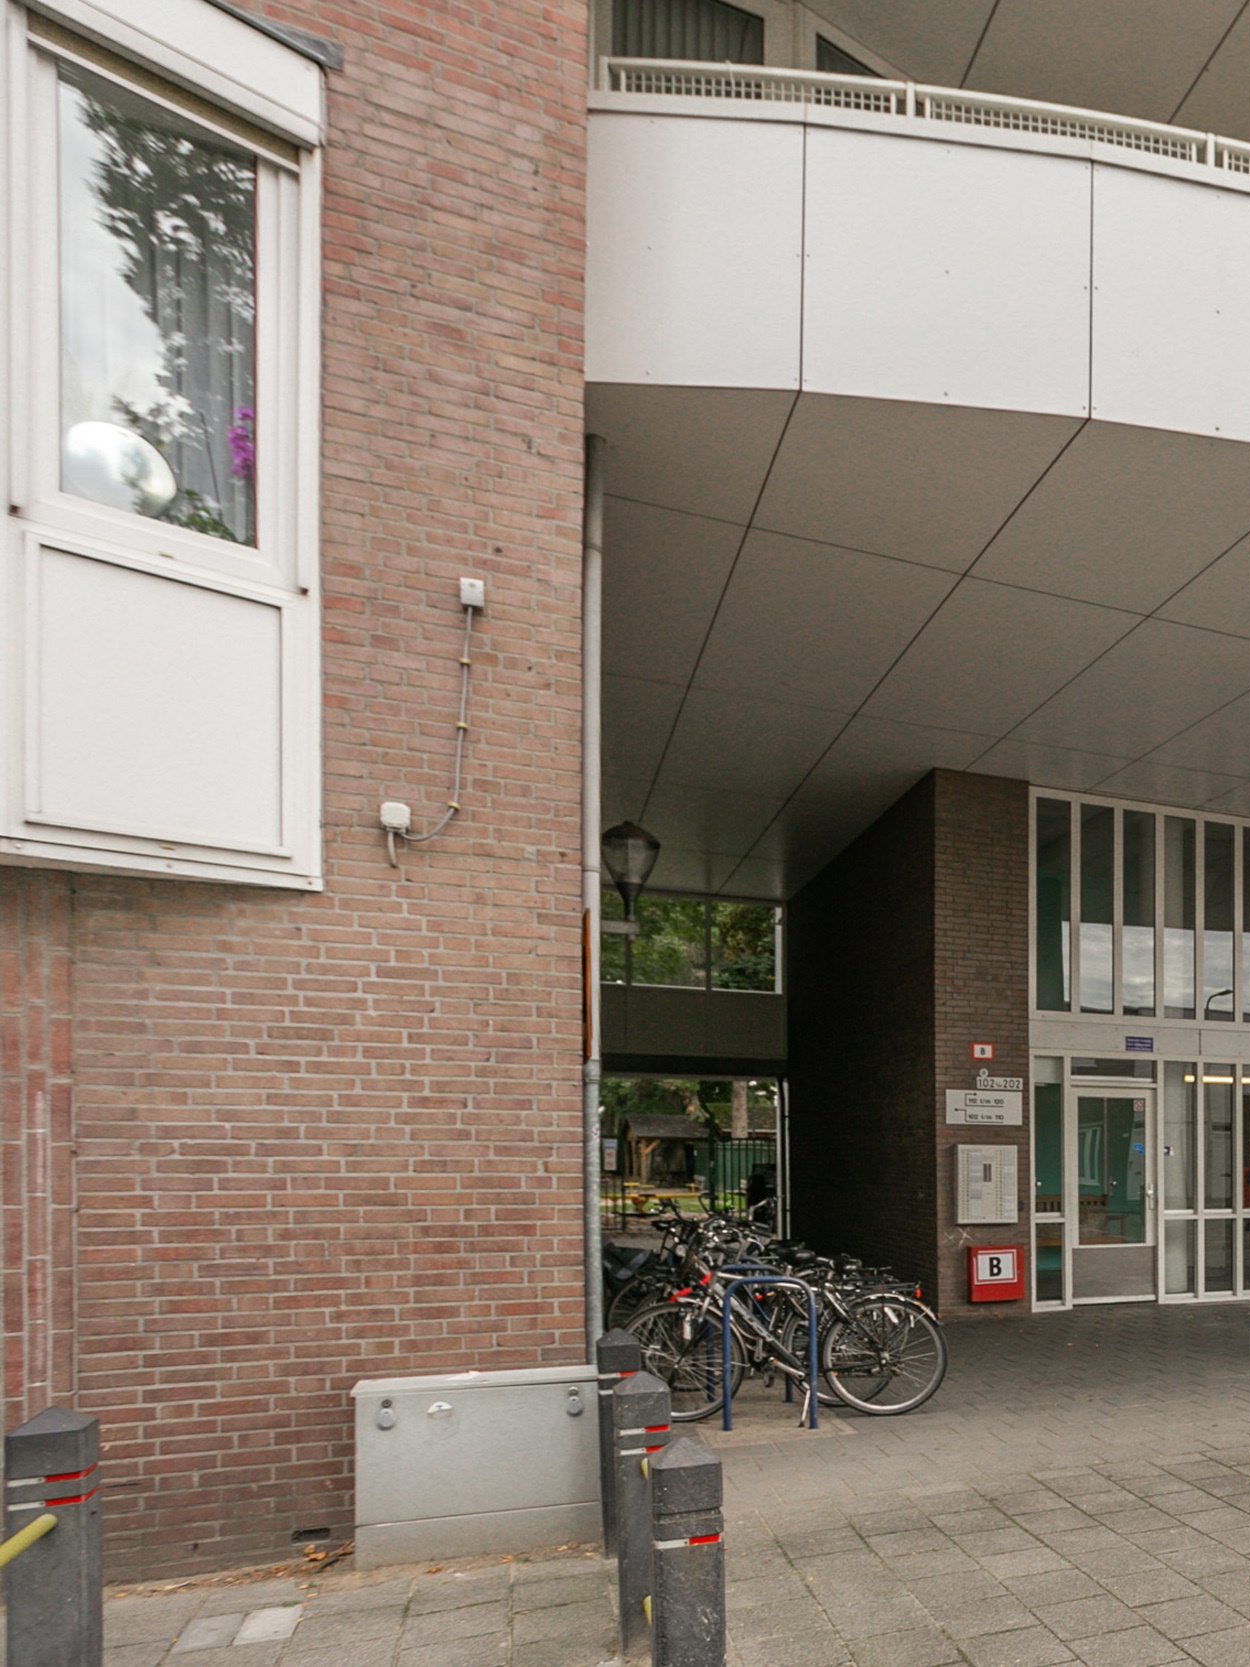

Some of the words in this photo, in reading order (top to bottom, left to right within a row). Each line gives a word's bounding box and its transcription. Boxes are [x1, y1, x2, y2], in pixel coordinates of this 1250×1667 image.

[980, 1047, 986, 1056] B
[979, 1079, 995, 1088] 102
[1003, 1079, 1021, 1089] 202
[989, 1256, 1002, 1277] B
